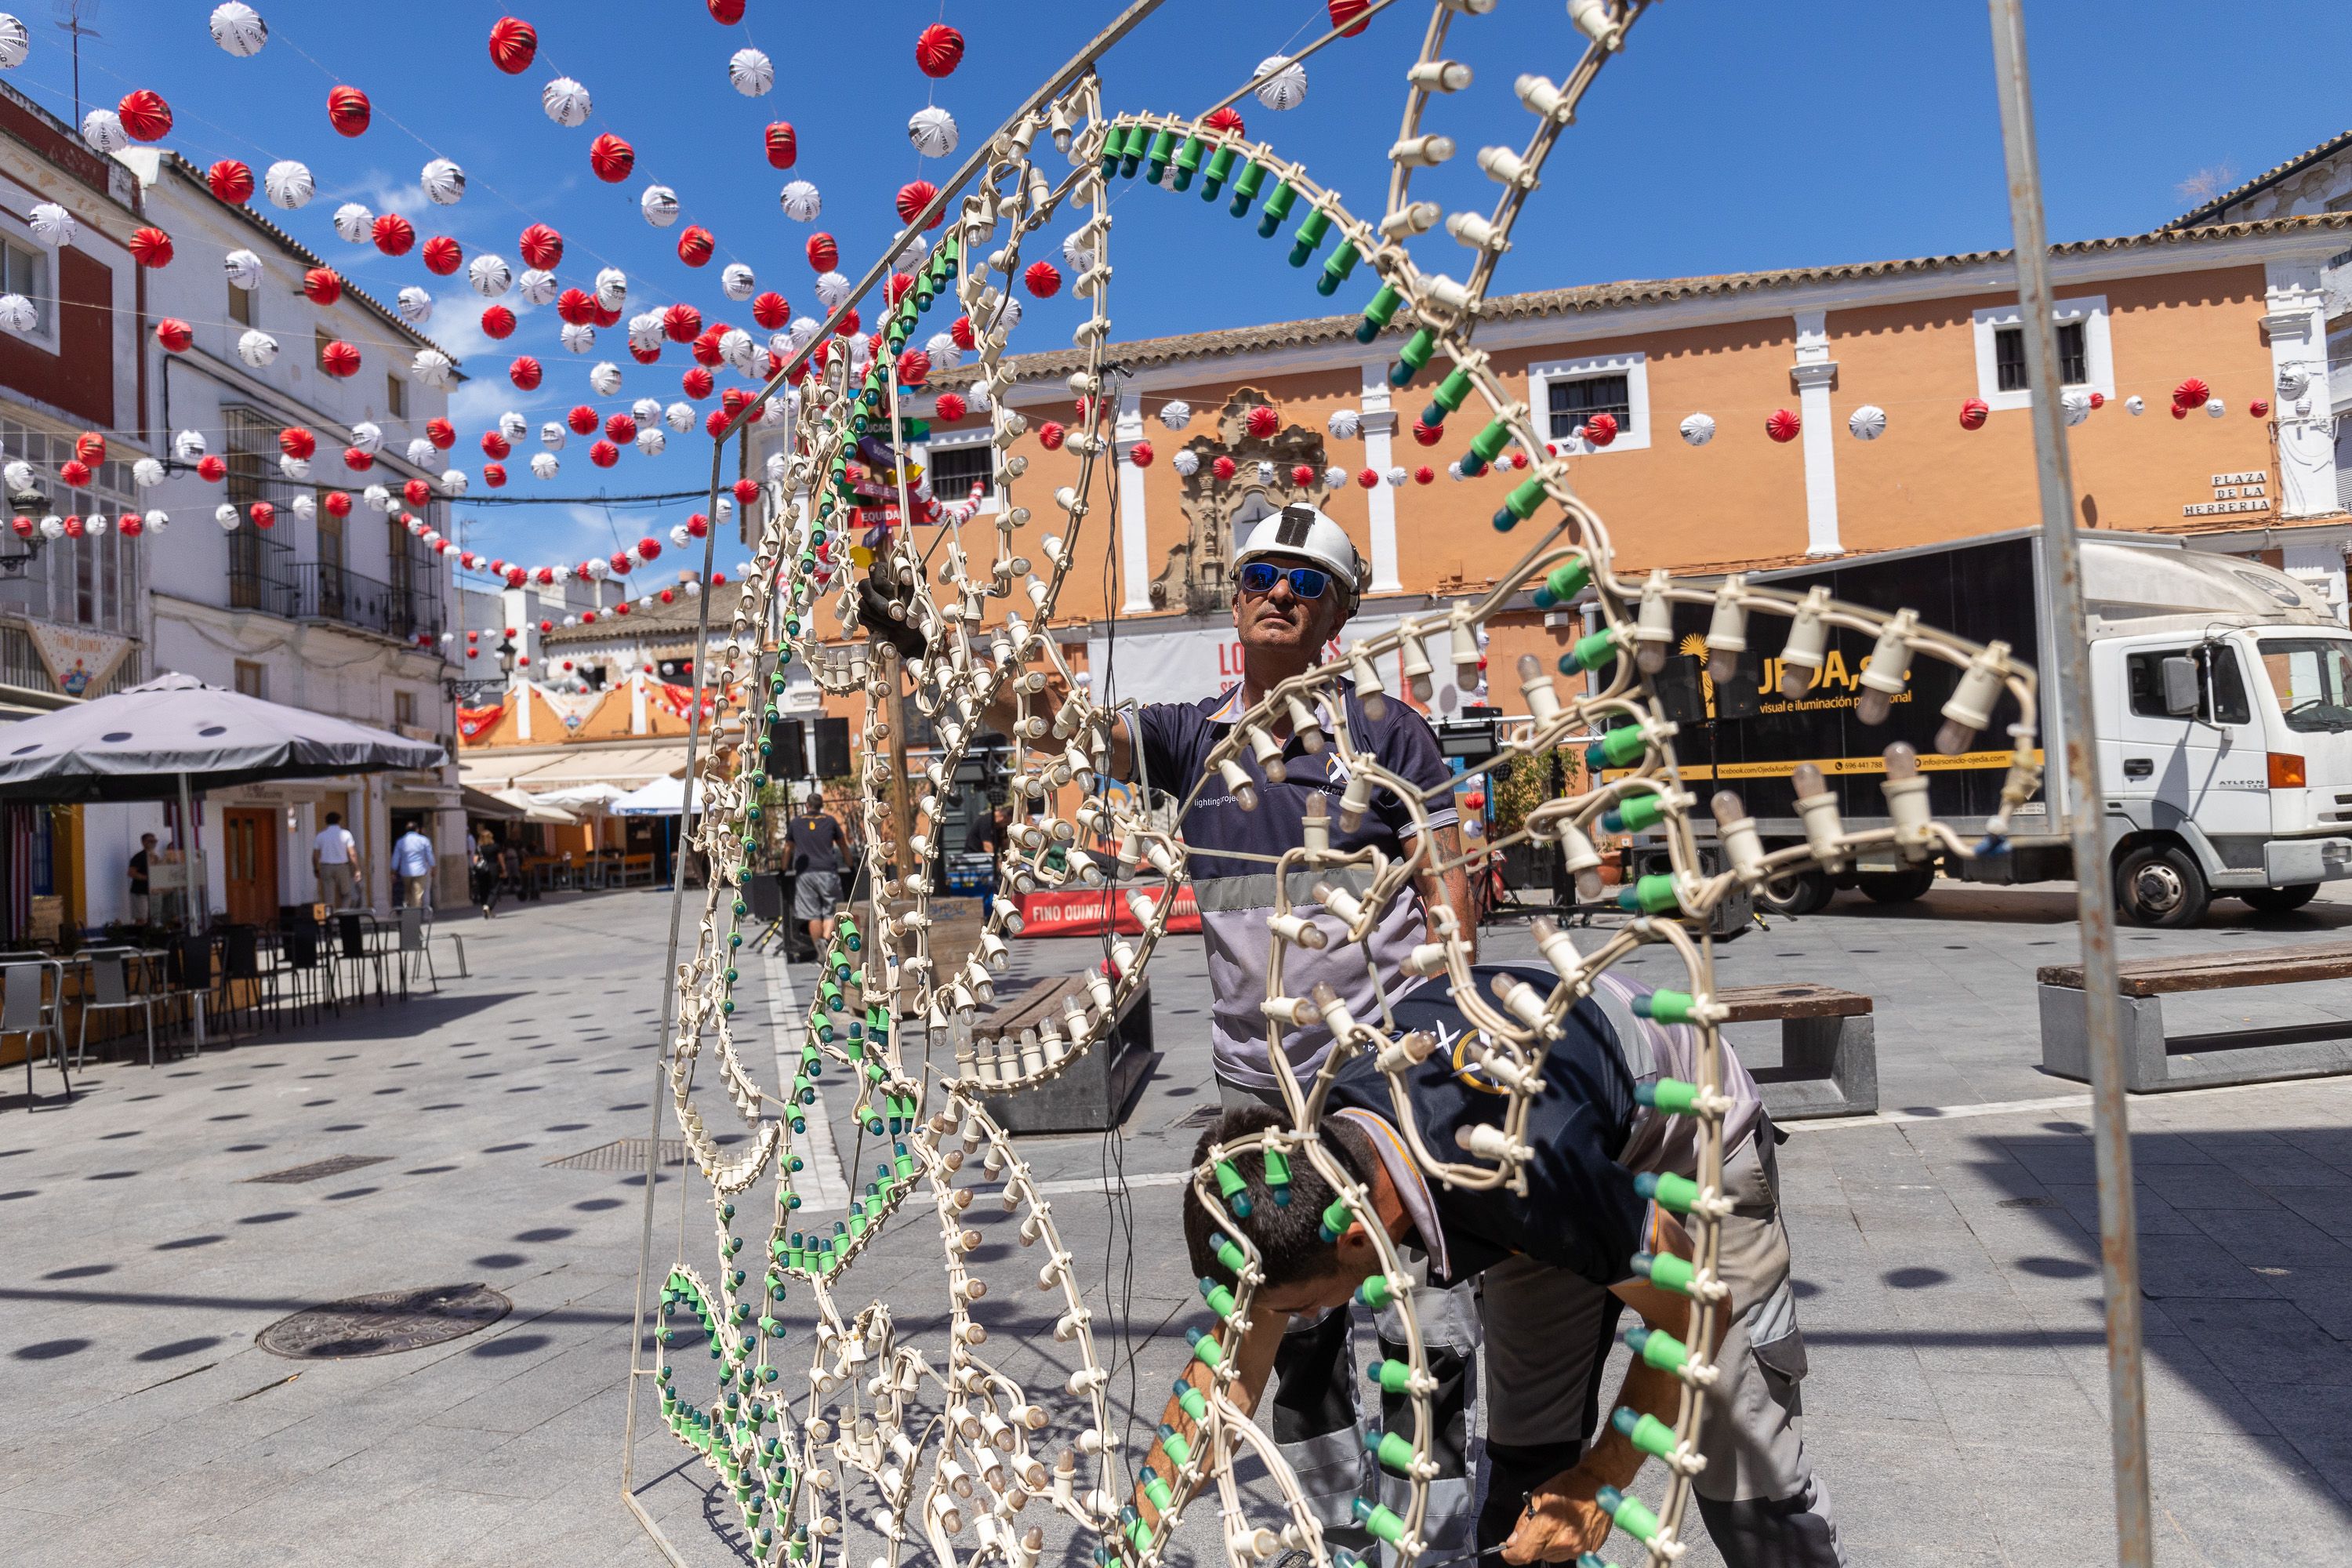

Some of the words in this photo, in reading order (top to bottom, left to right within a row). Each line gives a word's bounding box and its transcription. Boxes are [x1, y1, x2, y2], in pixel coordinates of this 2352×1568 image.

[2214, 473, 2265, 485] PLAZA
[2217, 488, 2236, 499] DE
[2244, 487, 2263, 496] LA
[2184, 500, 2269, 515] HERRERIA
[862, 510, 902, 522] EQUIDA
[1795, 696, 1852, 711] iluminación
[1853, 690, 1912, 710] pronal
[1033, 906, 1061, 922] FINO
[1065, 902, 1107, 921] QUINTA
[1170, 899, 1199, 916] QUIN
